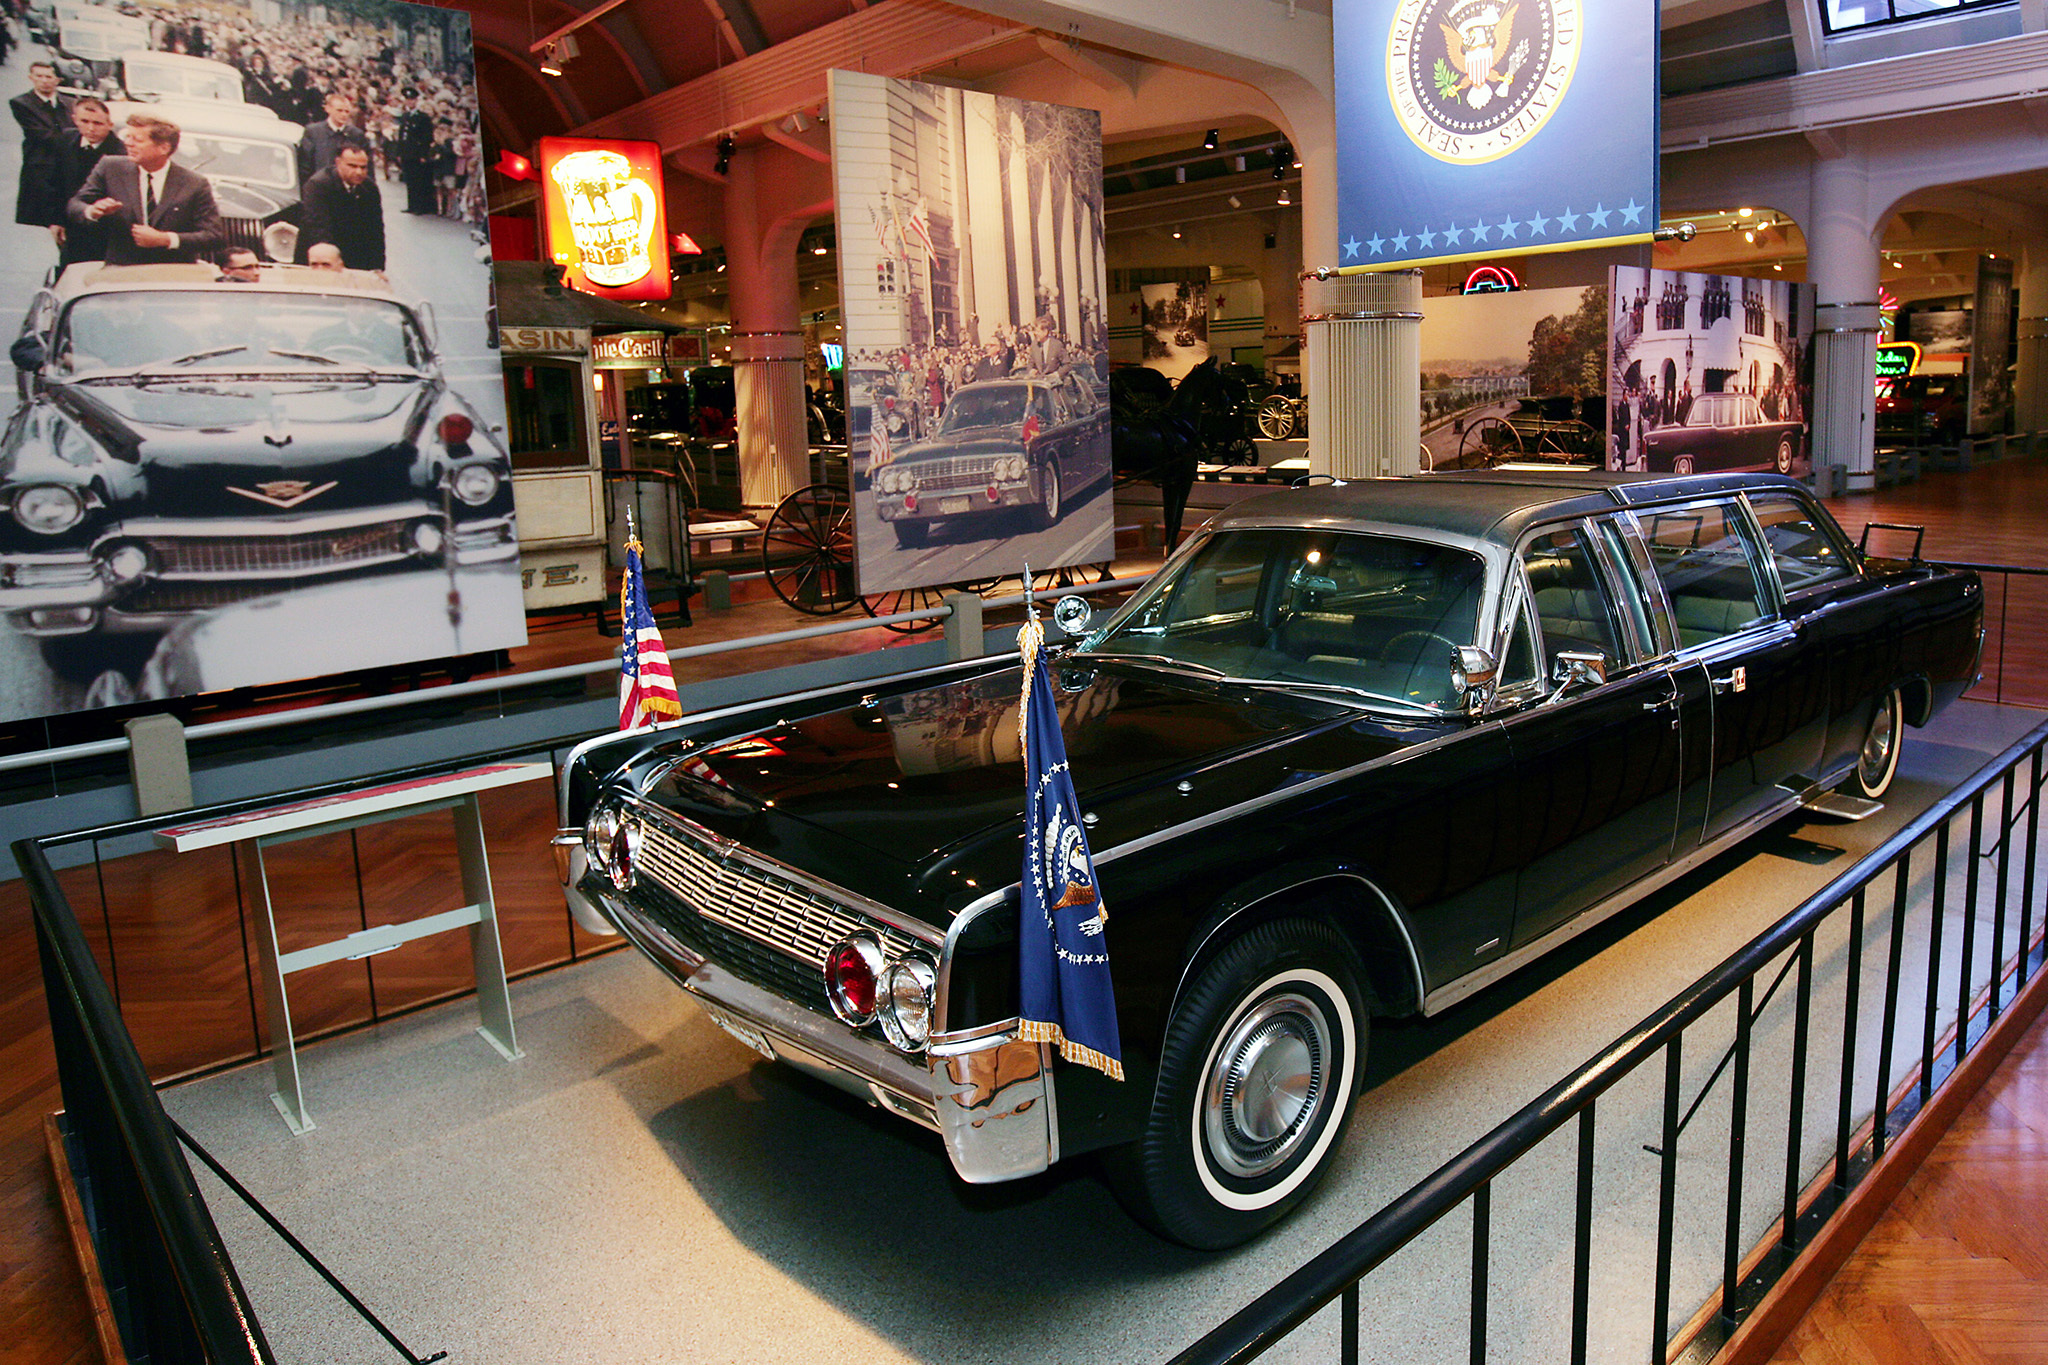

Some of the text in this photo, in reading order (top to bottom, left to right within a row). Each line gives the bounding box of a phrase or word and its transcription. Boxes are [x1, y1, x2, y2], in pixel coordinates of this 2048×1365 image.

[1394, 66, 1408, 97] THE
[1403, 101, 1416, 118] OF
[1500, 62, 1567, 146] STATES
[1417, 116, 1463, 156] SEAL
